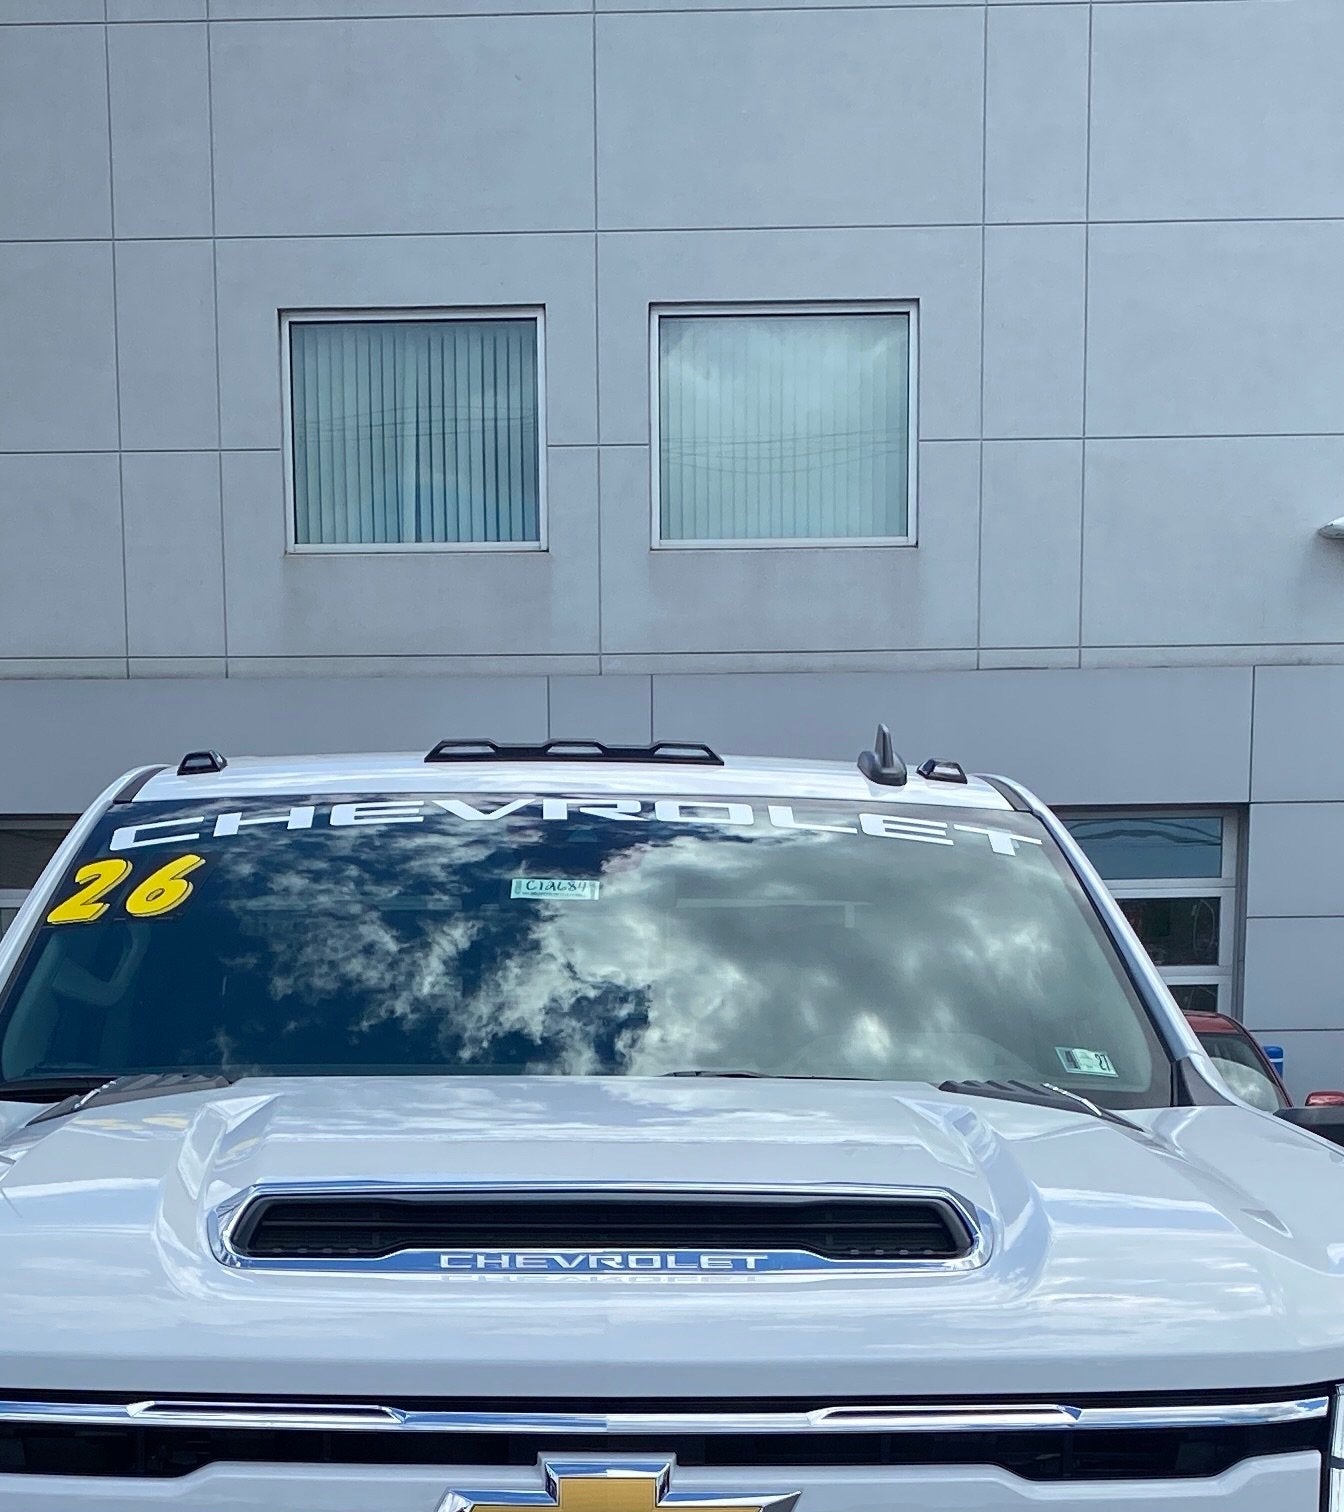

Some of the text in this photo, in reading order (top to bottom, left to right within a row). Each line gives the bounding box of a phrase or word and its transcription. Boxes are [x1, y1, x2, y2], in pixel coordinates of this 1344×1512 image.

[109, 798, 1043, 856] CHEVROLET
[47, 854, 206, 924] 26
[439, 1254, 768, 1269] CHEVROLET
